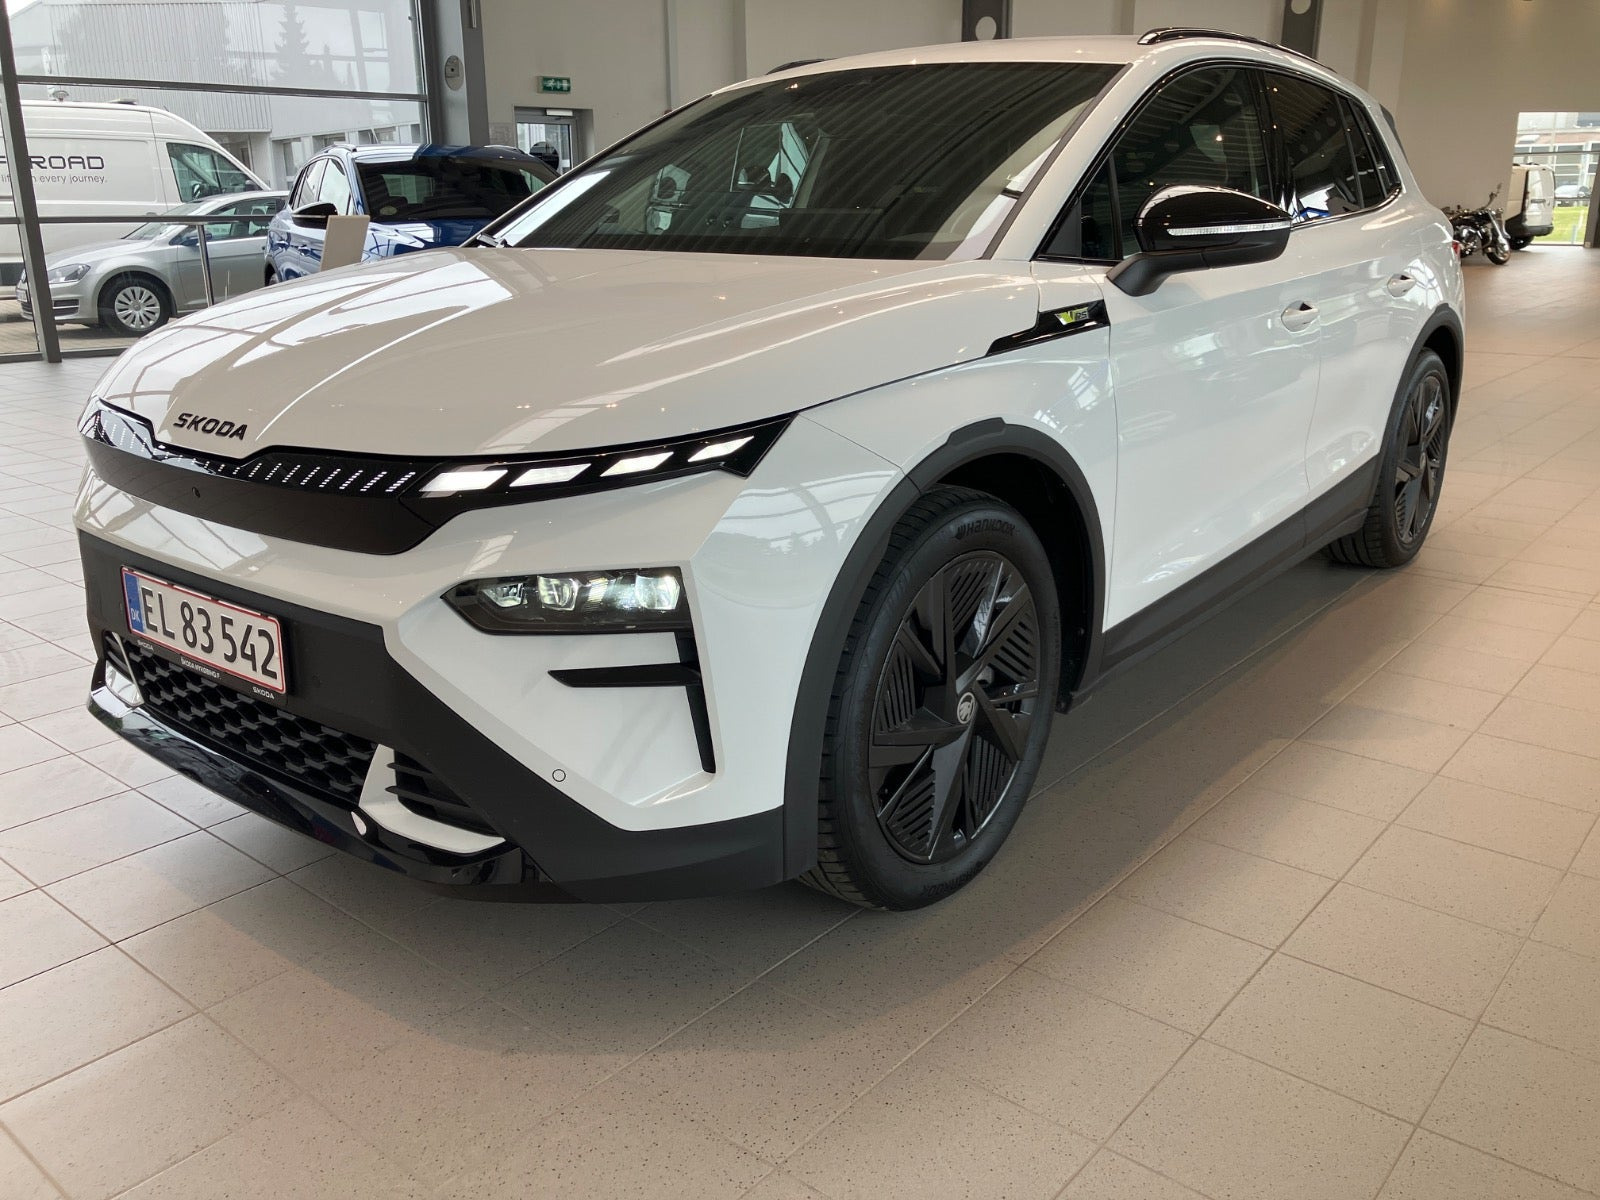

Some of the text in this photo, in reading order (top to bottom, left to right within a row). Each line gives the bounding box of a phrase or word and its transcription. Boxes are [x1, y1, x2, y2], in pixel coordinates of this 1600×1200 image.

[40, 175, 66, 184] every
[69, 174, 107, 184] journey.
[141, 586, 278, 680] EL 83 542
